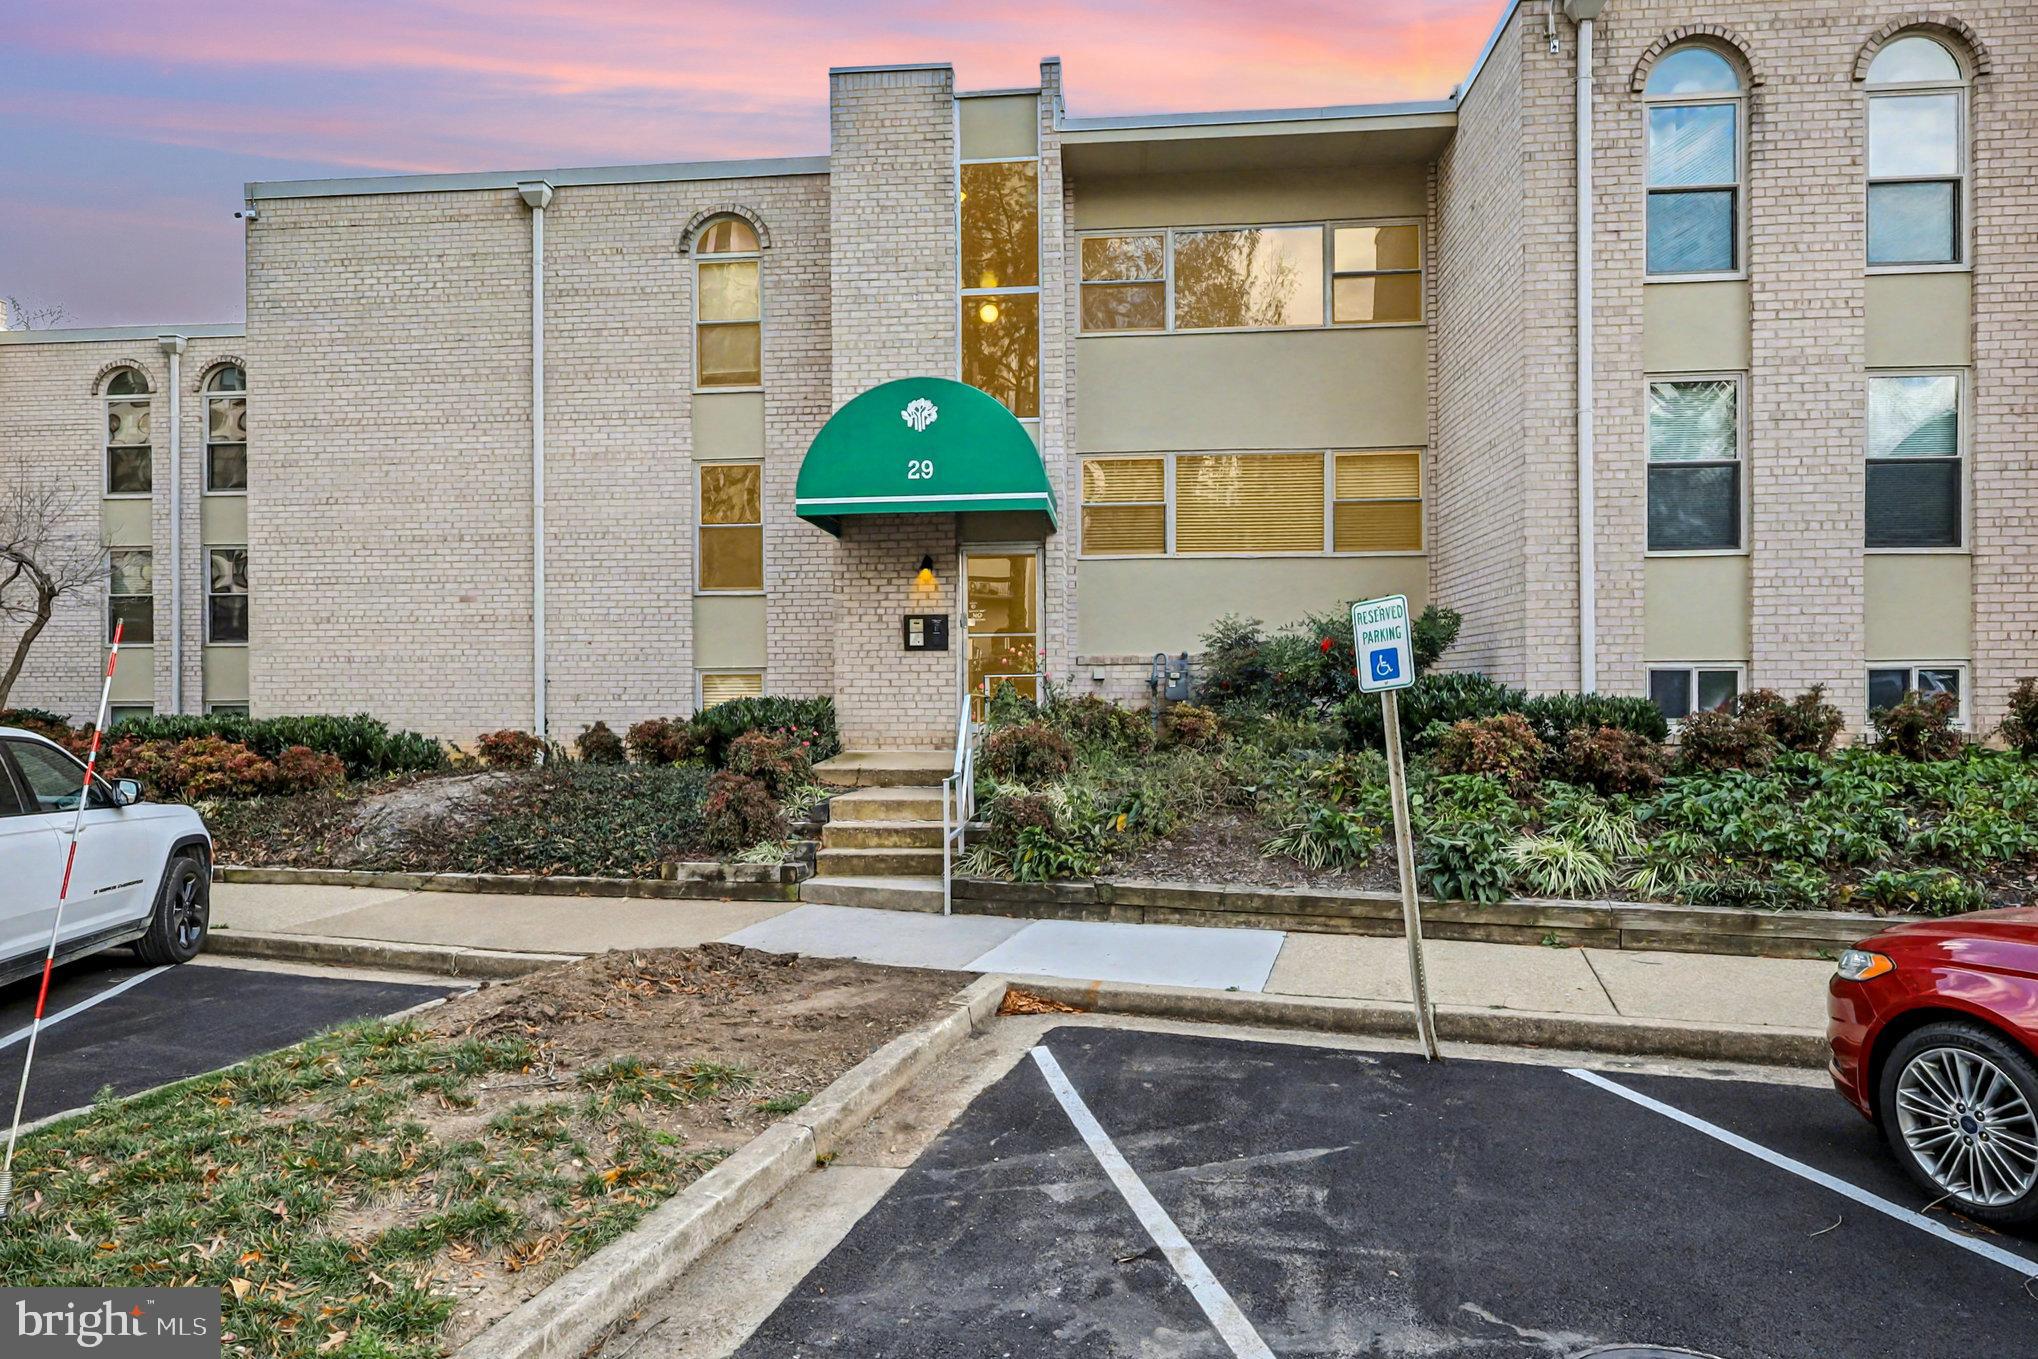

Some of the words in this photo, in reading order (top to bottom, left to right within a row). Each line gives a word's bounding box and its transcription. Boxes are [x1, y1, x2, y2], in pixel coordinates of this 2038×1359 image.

[907, 459, 934, 480] 29
[1356, 605, 1403, 625] RESERVED
[1362, 626, 1401, 645] PARKING
